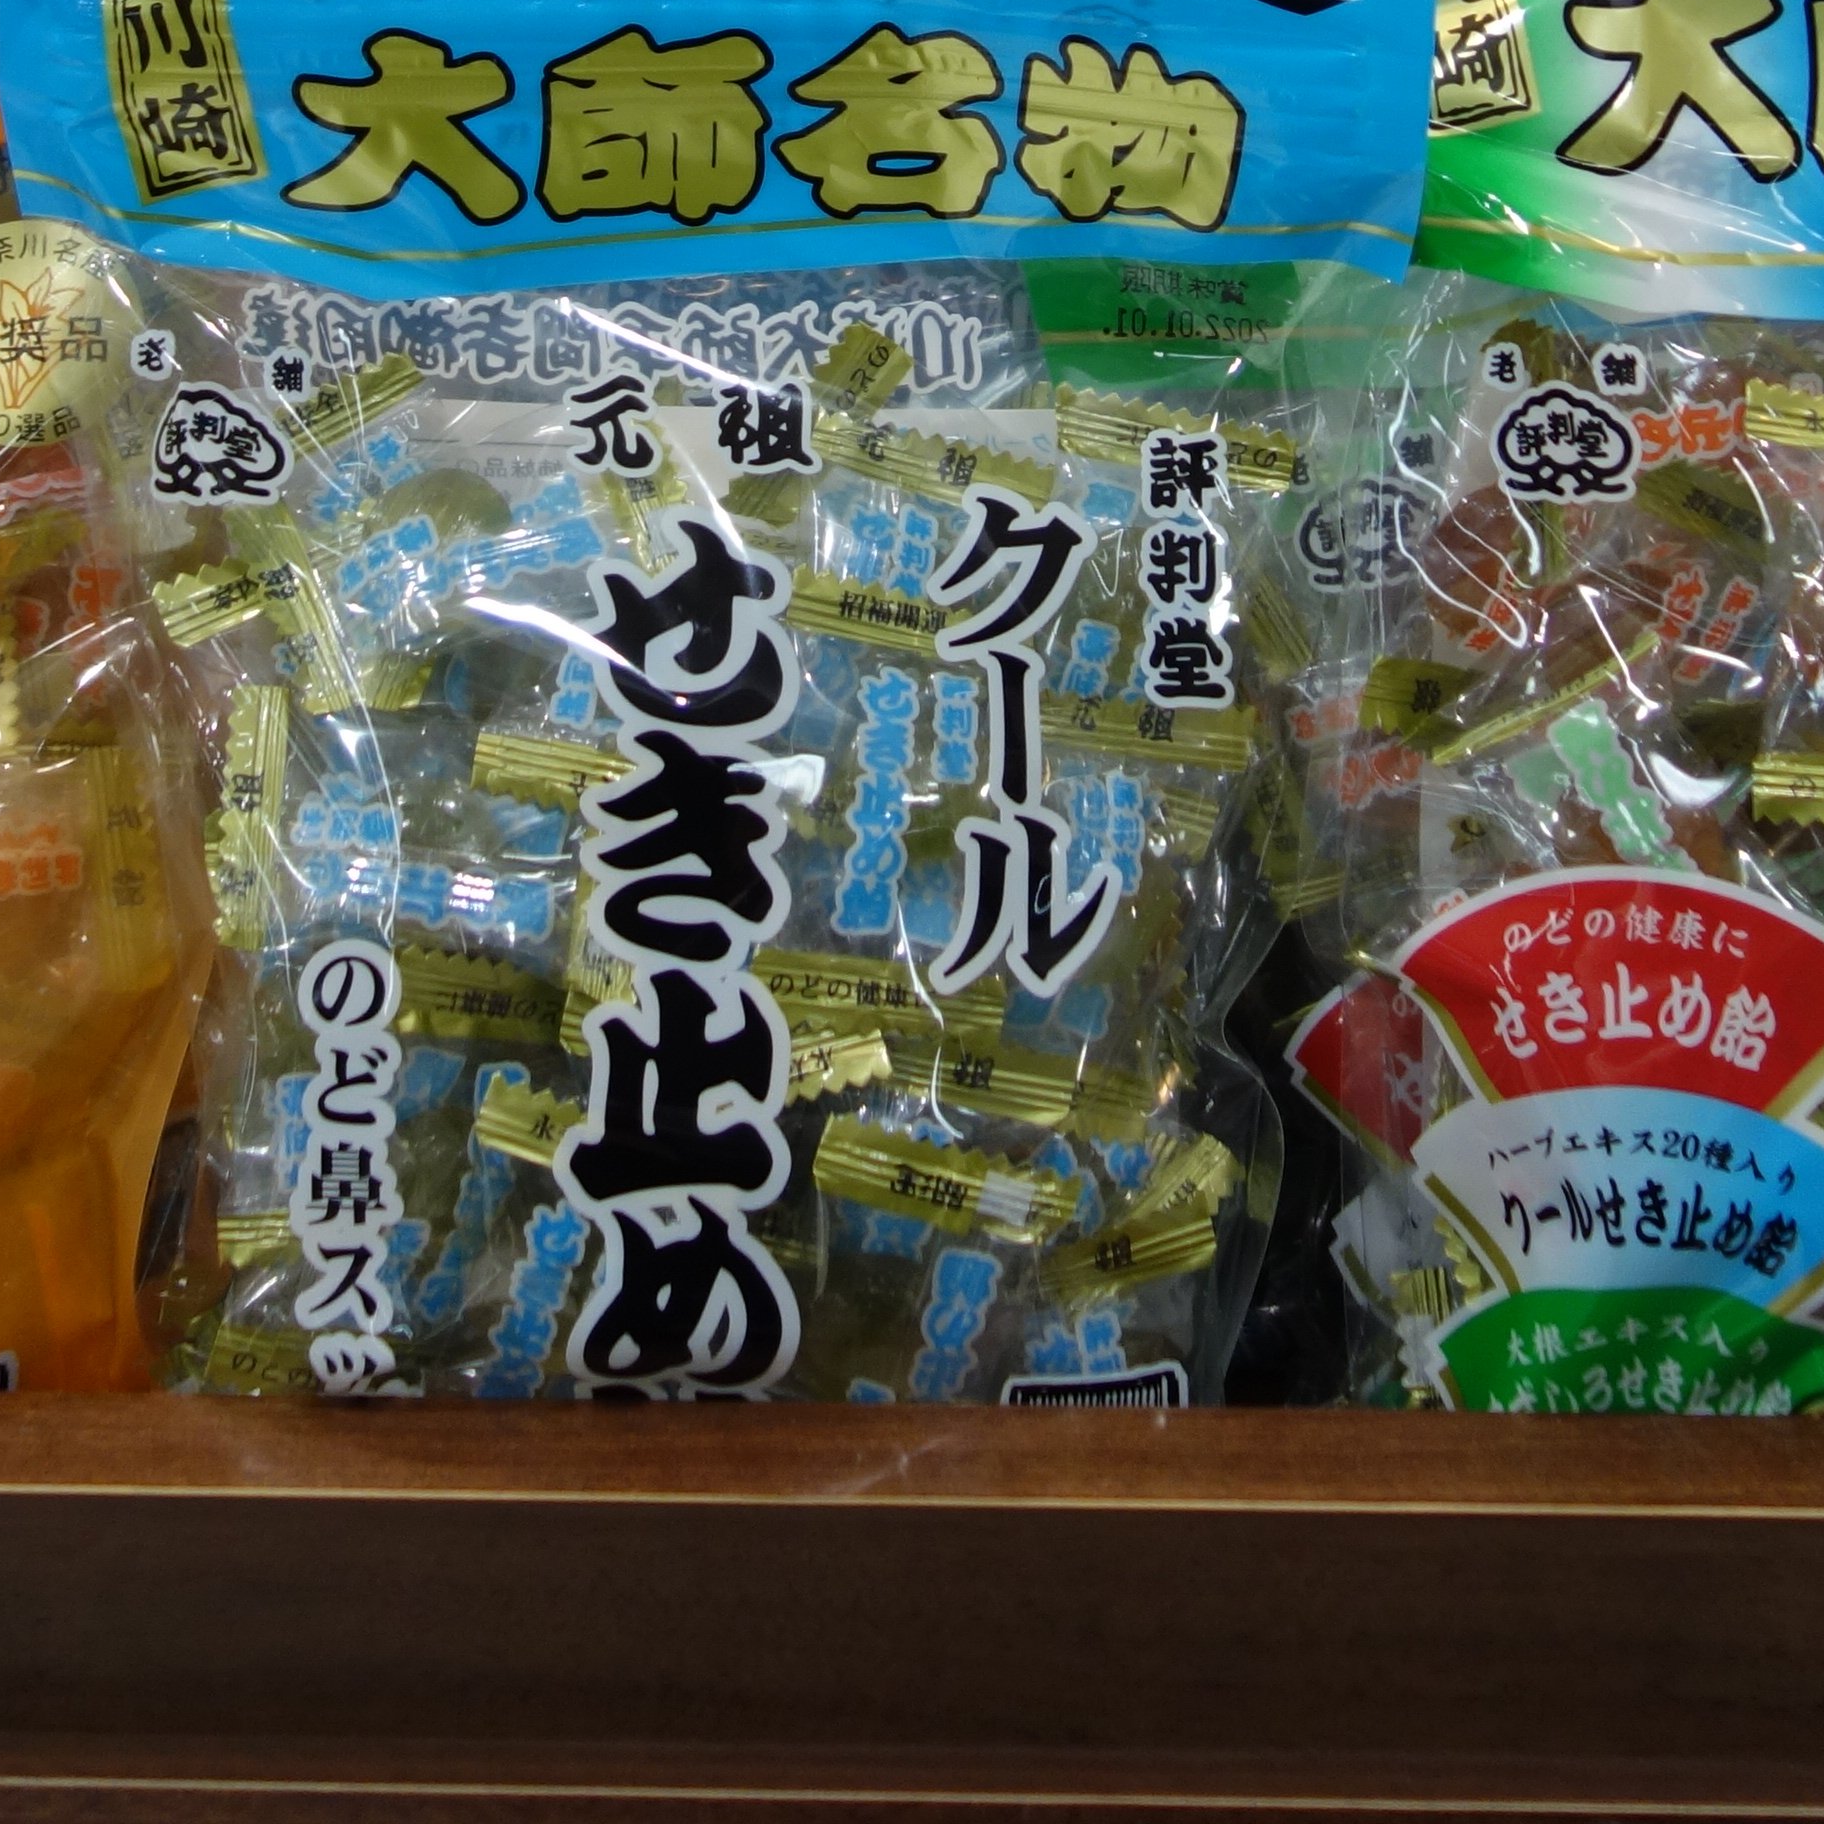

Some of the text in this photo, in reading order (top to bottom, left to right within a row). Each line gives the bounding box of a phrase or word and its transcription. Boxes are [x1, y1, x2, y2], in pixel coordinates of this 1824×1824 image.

[281, 22, 1248, 234] 大師名物
[572, 377, 813, 470] 元祖
[1513, 410, 1610, 459] 評判堂
[1149, 436, 1228, 702] 評判堂
[940, 495, 1113, 982] クール
[569, 522, 785, 1400] せき止め
[1502, 902, 1749, 960] のどの健康に
[1492, 961, 1776, 1072] せき止め飴
[1499, 1178, 1798, 1277] クールせき止め飴
